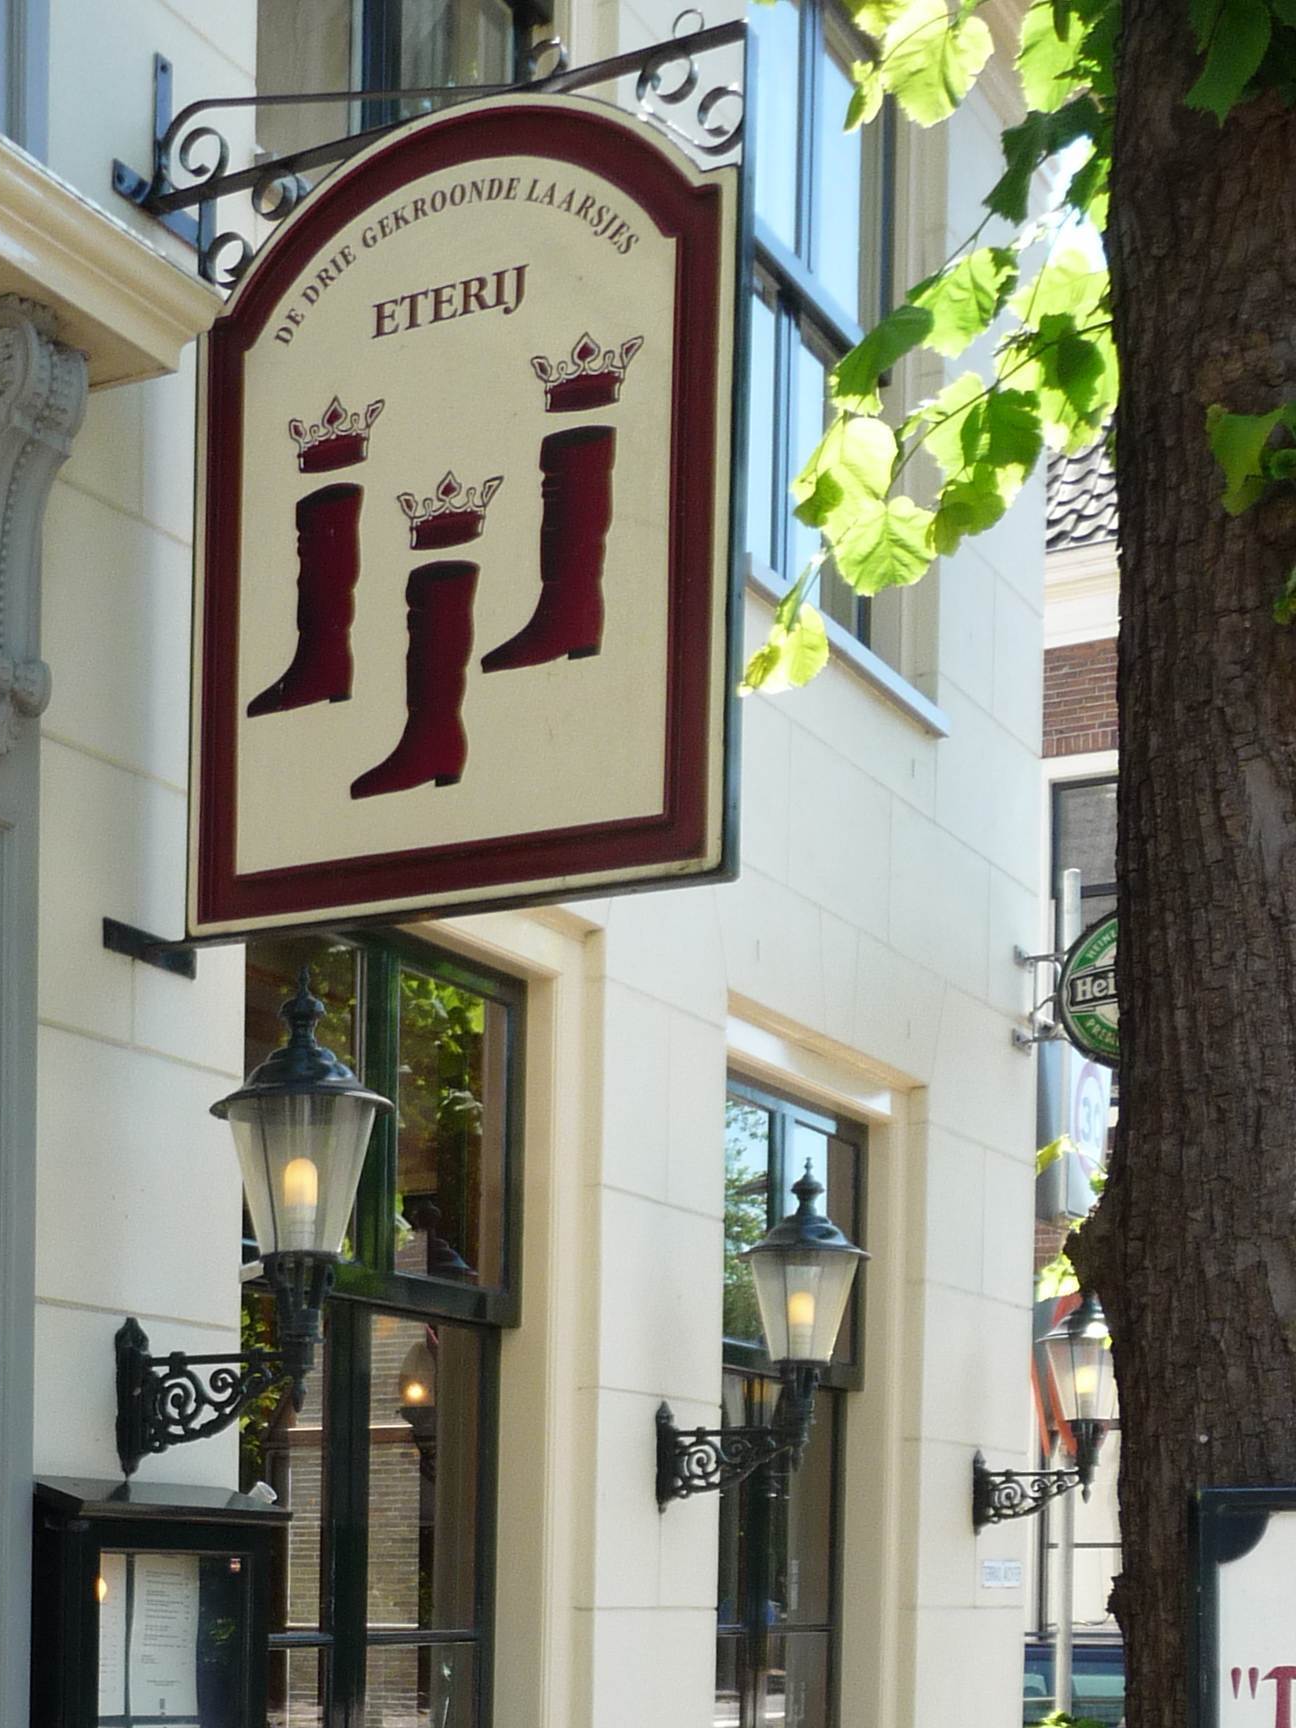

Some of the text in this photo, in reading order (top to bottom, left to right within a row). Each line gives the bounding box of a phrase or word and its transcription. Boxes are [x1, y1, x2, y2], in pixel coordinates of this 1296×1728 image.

[274, 176, 640, 346] DE DRIE GEKROONDE LAARSJES
[370, 262, 531, 340] ETERIJ
